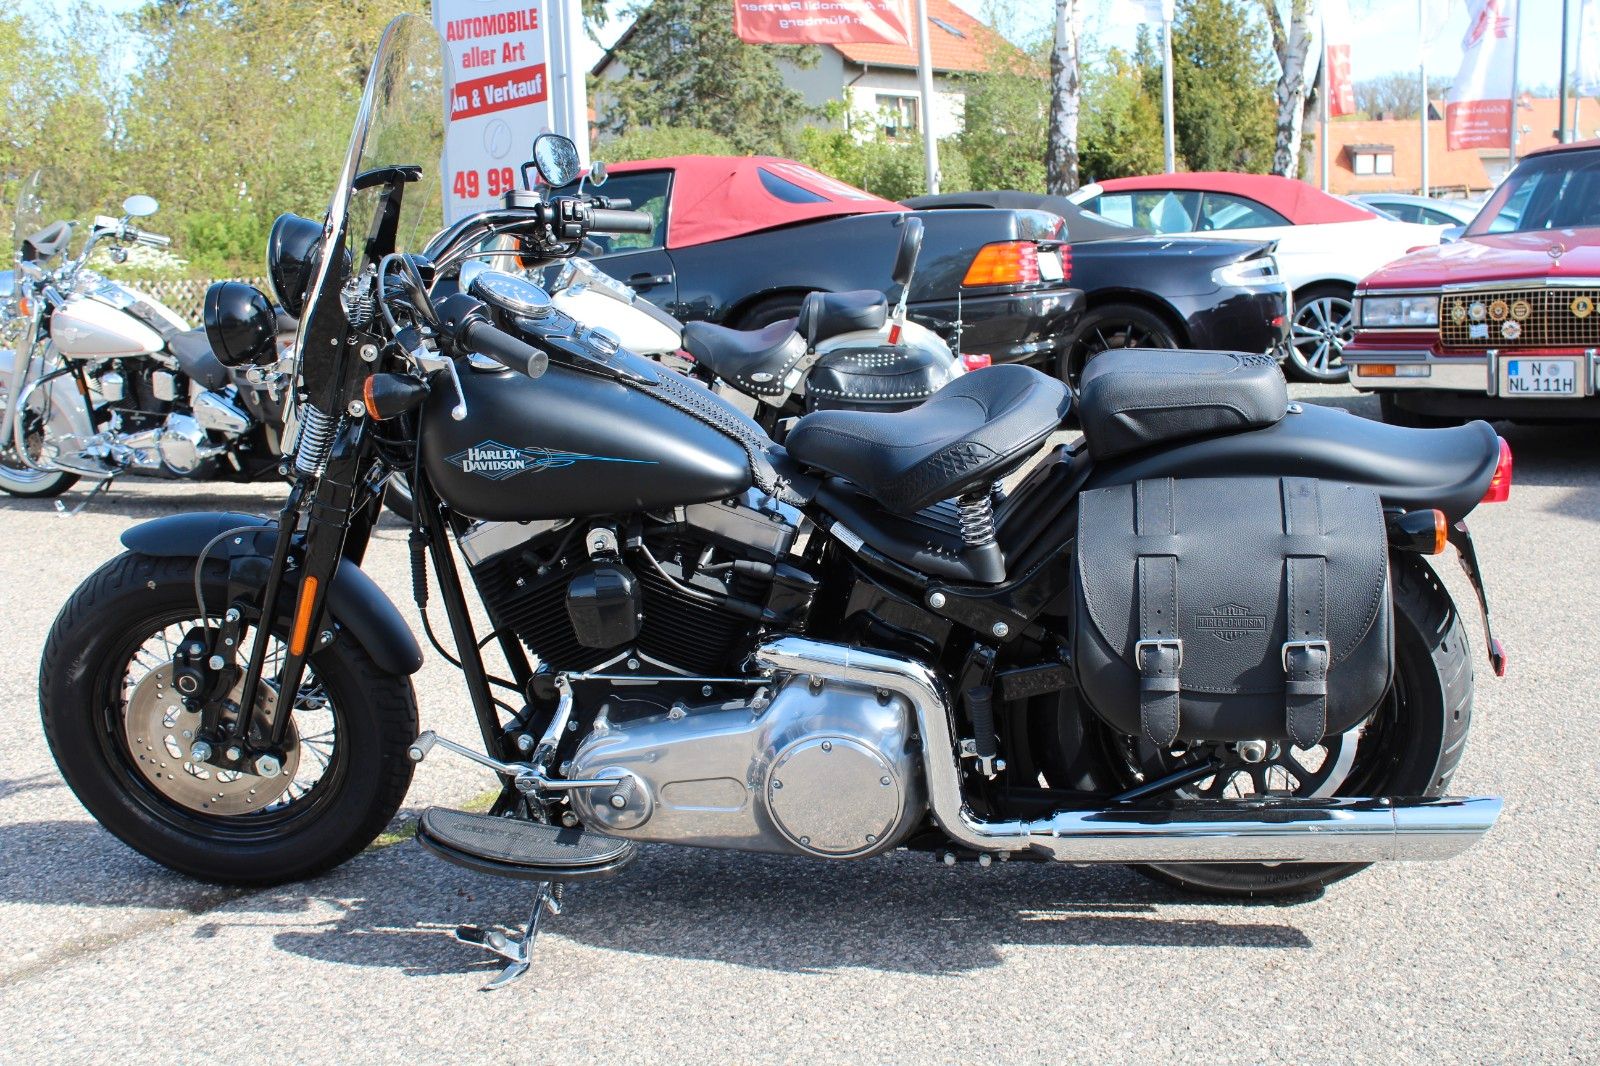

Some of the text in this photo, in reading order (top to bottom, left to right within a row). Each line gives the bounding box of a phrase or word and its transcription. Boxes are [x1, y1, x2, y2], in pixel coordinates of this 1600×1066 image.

[447, 8, 538, 41] AUTOMOBILE
[462, 42, 526, 68] aller Art
[452, 73, 543, 112] An & Verkauf
[453, 170, 479, 199] 49
[487, 167, 514, 197] 99
[1532, 363, 1541, 376] N
[1509, 378, 1573, 391] NL 111H
[463, 459, 525, 472] DAVIDSON
[1199, 617, 1264, 628] HARLEY-DAVIDSON
